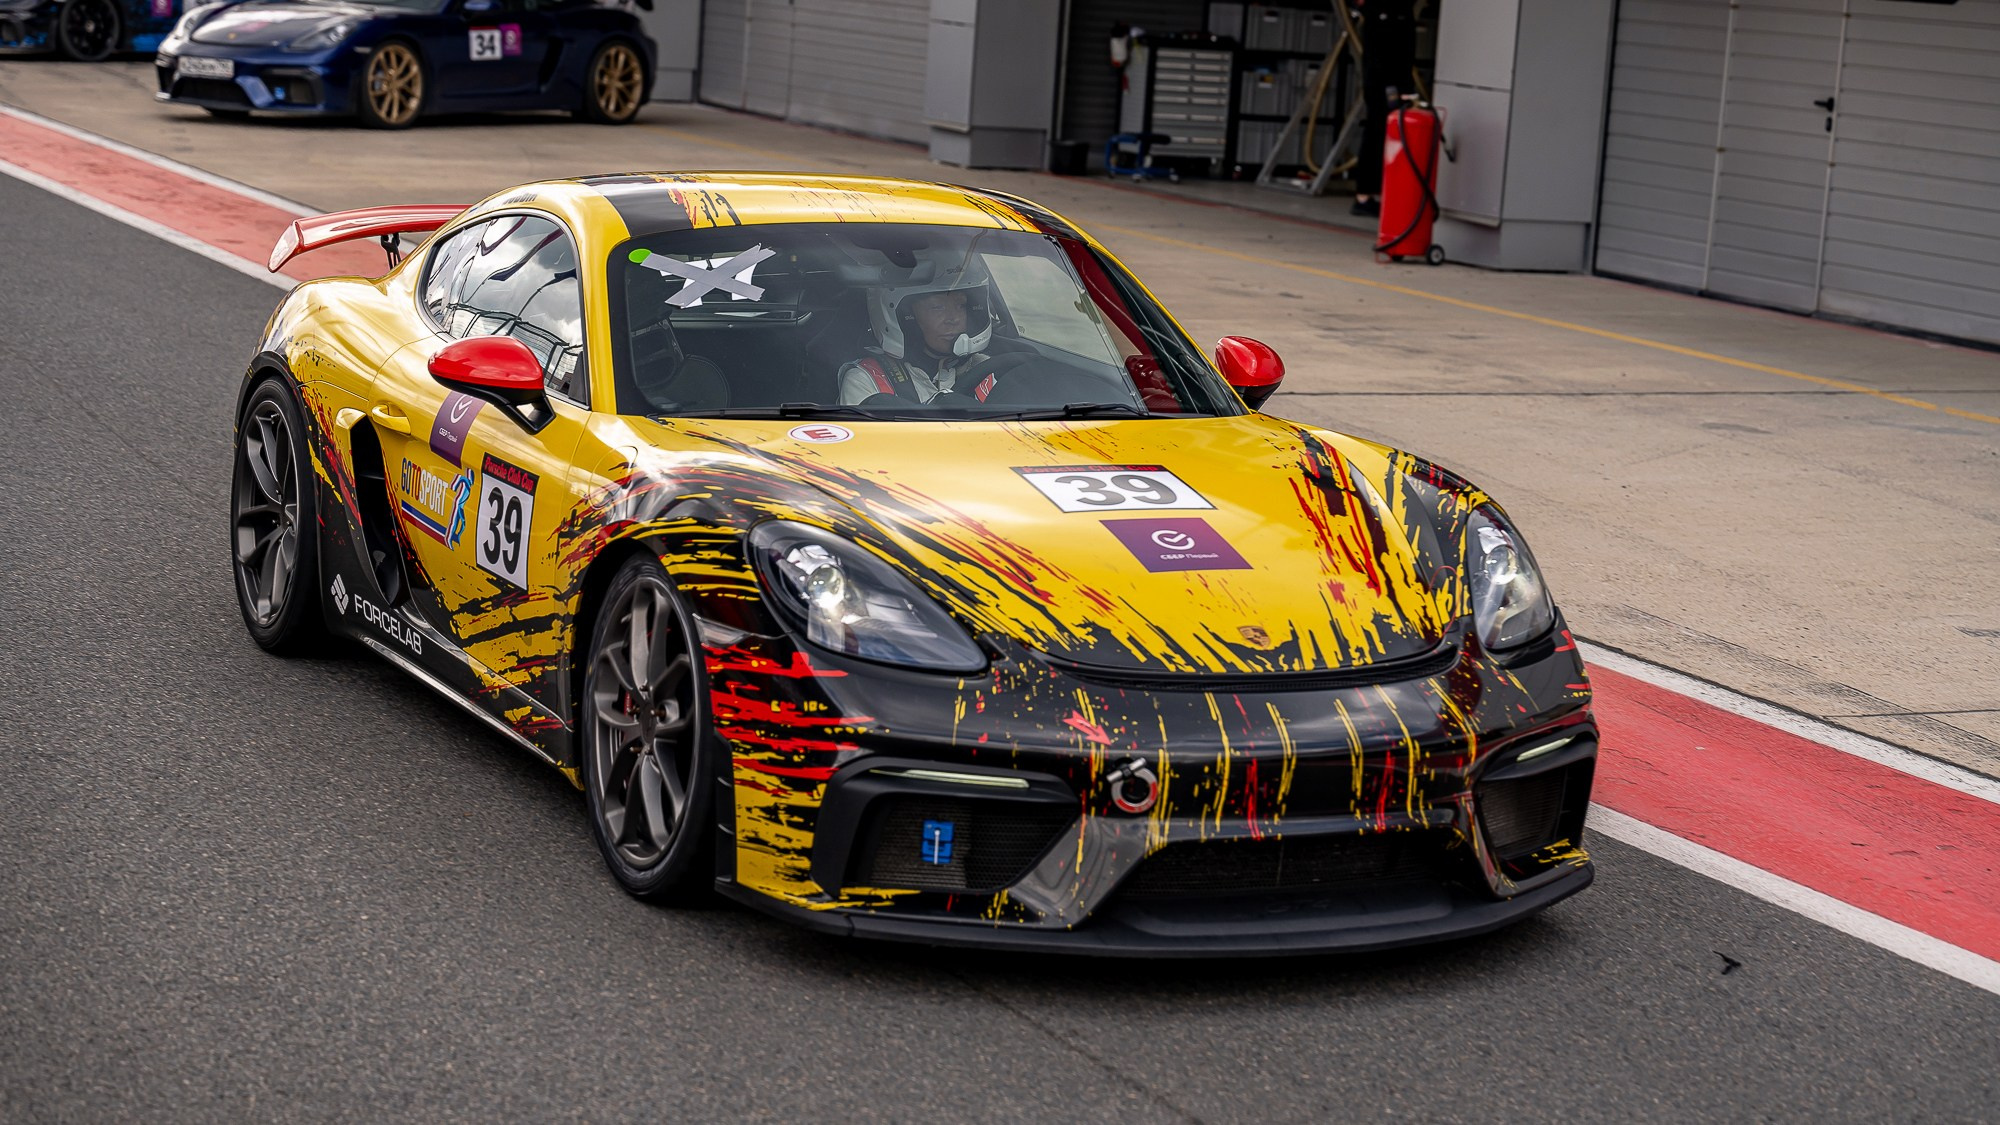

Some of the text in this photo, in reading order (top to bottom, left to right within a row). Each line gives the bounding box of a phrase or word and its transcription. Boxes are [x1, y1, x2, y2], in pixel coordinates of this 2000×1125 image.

[476, 34, 495, 56] 34
[484, 456, 534, 493] Porsche Club Cup
[1022, 465, 1085, 473] Porsche
[1055, 474, 1177, 505] 39
[483, 487, 522, 574] 39
[354, 594, 422, 655] FORCELAB
